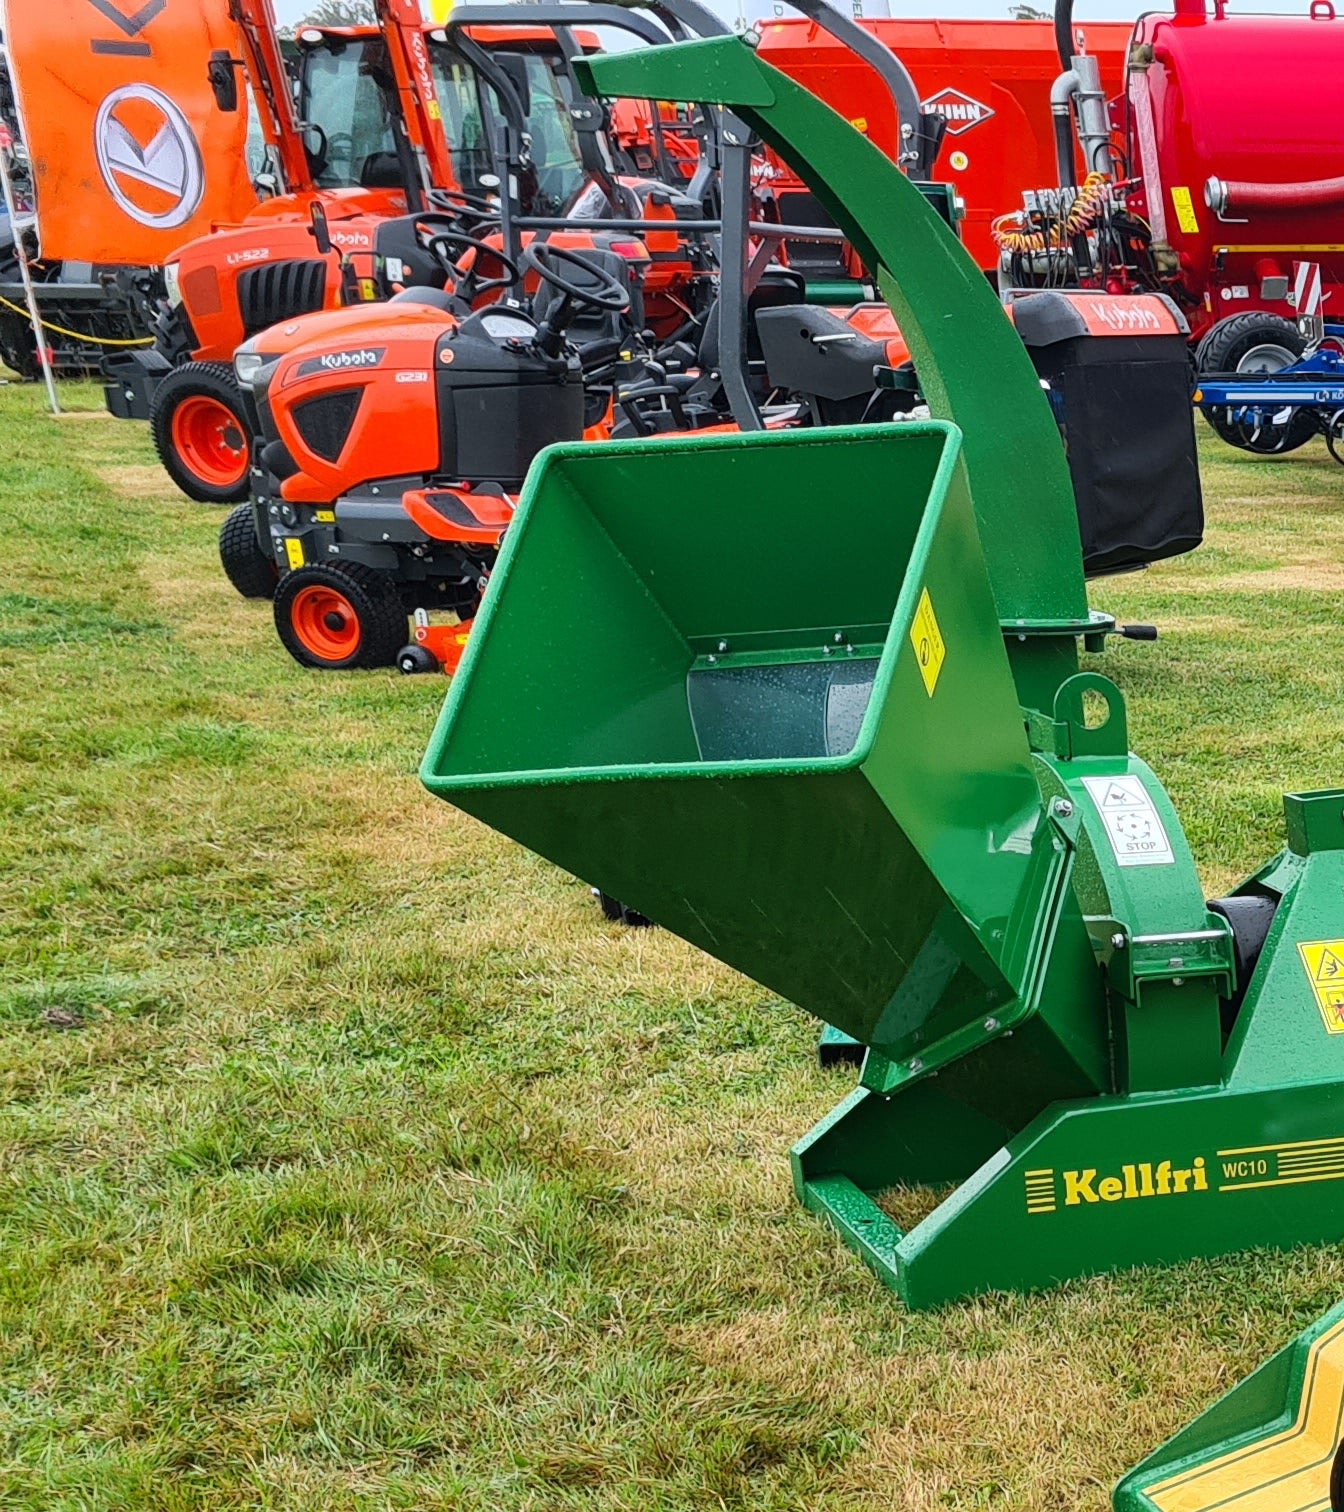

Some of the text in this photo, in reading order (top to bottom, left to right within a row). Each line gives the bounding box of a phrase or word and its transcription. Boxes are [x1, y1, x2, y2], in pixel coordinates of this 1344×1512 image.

[412, 31, 433, 100] Kubota
[329, 231, 369, 246] ubota
[1090, 303, 1160, 330] Kubota
[321, 350, 377, 369] Kubota
[1126, 841, 1157, 851] STOP
[1062, 1156, 1267, 1206] Kellfri WC10
